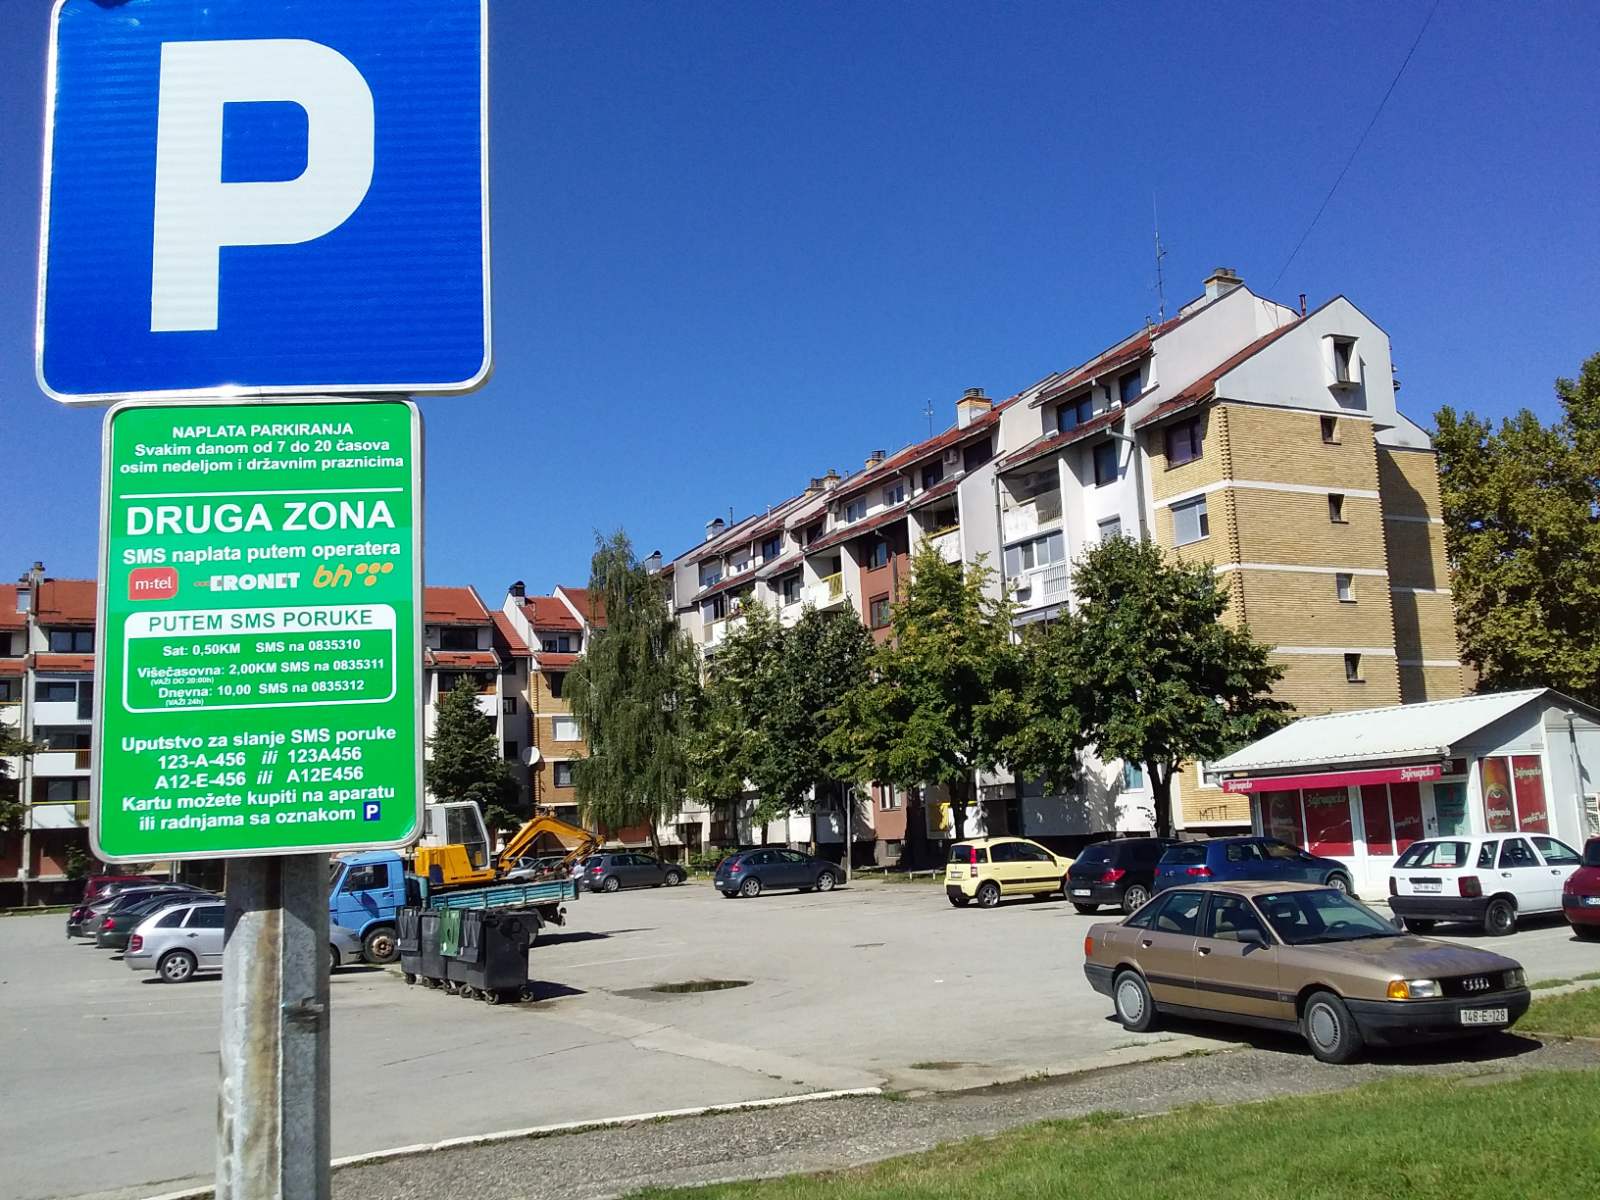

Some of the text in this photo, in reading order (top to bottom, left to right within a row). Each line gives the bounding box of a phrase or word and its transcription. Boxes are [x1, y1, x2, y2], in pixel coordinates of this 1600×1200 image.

[150, 38, 375, 332] P
[172, 423, 353, 438] NAPLATA PARKIRANJA
[135, 439, 390, 457] Svakim danom od 7 do 20 časova
[120, 456, 403, 474] osim nedeljom i državnim praznicima
[126, 500, 395, 535] DRUGA ZONA
[123, 542, 400, 564] SMS naplata putem operatera
[210, 573, 300, 592] ERONET
[149, 610, 372, 632] PUTEM SMS PORUKE
[163, 639, 360, 656] Sat: 0,50KM SMS na 0835310
[228, 662, 277, 675] 2,00KM
[280, 661, 310, 672] SMS
[314, 661, 329, 671] na
[333, 659, 384, 670] 0835311
[159, 687, 212, 698] Dnevna:
[259, 683, 288, 694] SMS
[292, 683, 308, 693] na
[311, 680, 364, 691] 0835312
[122, 726, 397, 753] Uputstvo za slanje SMS poruke
[158, 747, 362, 769] 123-A-456 ili 123A456
[155, 766, 364, 789] A12-E-456 ili A12E456
[122, 786, 394, 811] Kartu možete kupiti na aparatu
[139, 805, 378, 831] ili radnjama sa oznakom P
